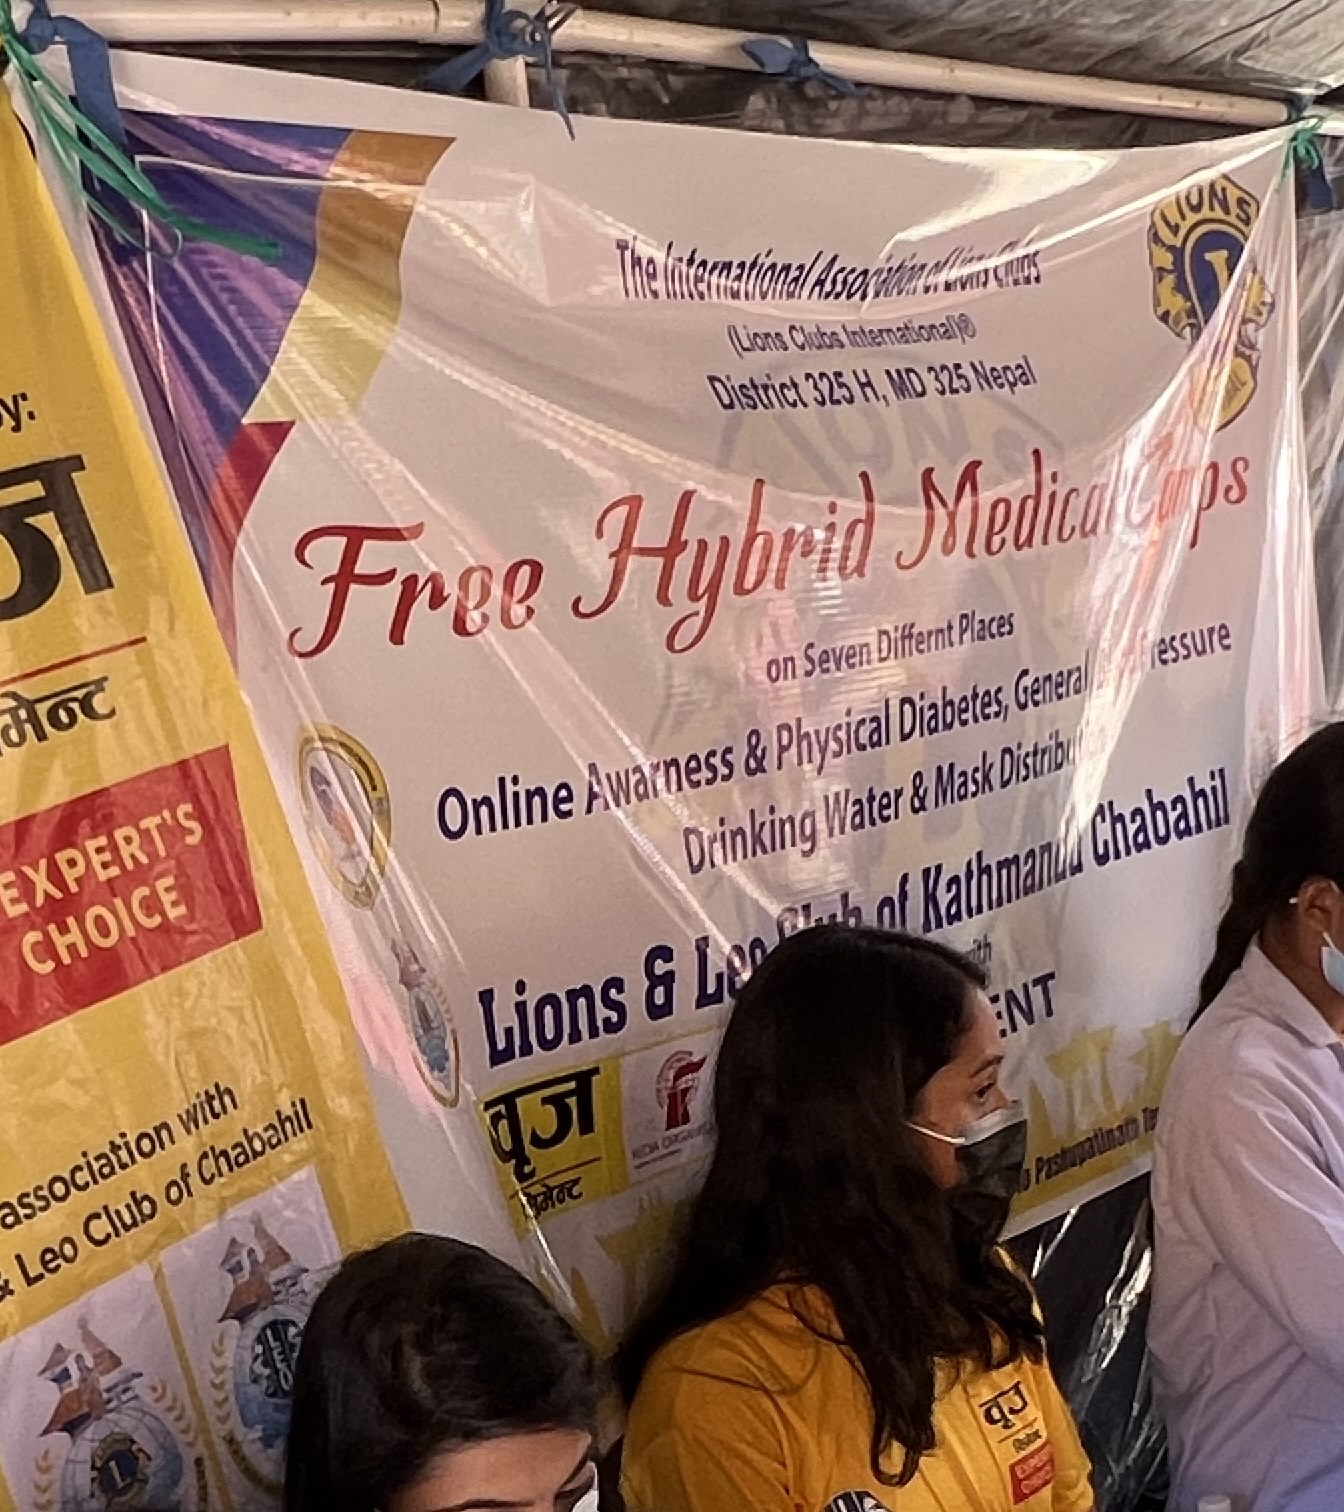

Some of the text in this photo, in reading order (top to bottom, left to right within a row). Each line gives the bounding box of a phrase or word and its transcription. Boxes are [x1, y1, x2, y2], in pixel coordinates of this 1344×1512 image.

[615, 236, 660, 300] The
[661, 241, 823, 301] International
[706, 354, 1039, 412] District 325 H, MD 325 Nepal
[727, 324, 788, 359] (Lions
[789, 324, 846, 351] Clubs
[287, 521, 545, 659] Free
[570, 471, 877, 655] Hybrid
[766, 608, 1016, 684] on Seven Differnt Places
[437, 621, 1233, 842] Online Awarness & Physical Diabetes, General ressure
[683, 800, 818, 876] Drinking
[824, 778, 904, 844] Water
[910, 770, 929, 813] &
[934, 750, 995, 805] Mask
[21, 874, 189, 976] CHOICE
[478, 979, 628, 1069] Lions
[643, 945, 676, 1022] &
[876, 872, 910, 929] of
[1090, 767, 1231, 868] Chabahil
[177, 1080, 240, 1137] with
[483, 1067, 601, 1184] वृज
[14, 1236, 79, 1289] Leo
[83, 1190, 159, 1248] Club
[163, 1163, 194, 1207] of
[196, 1097, 315, 1187] Chabahil
